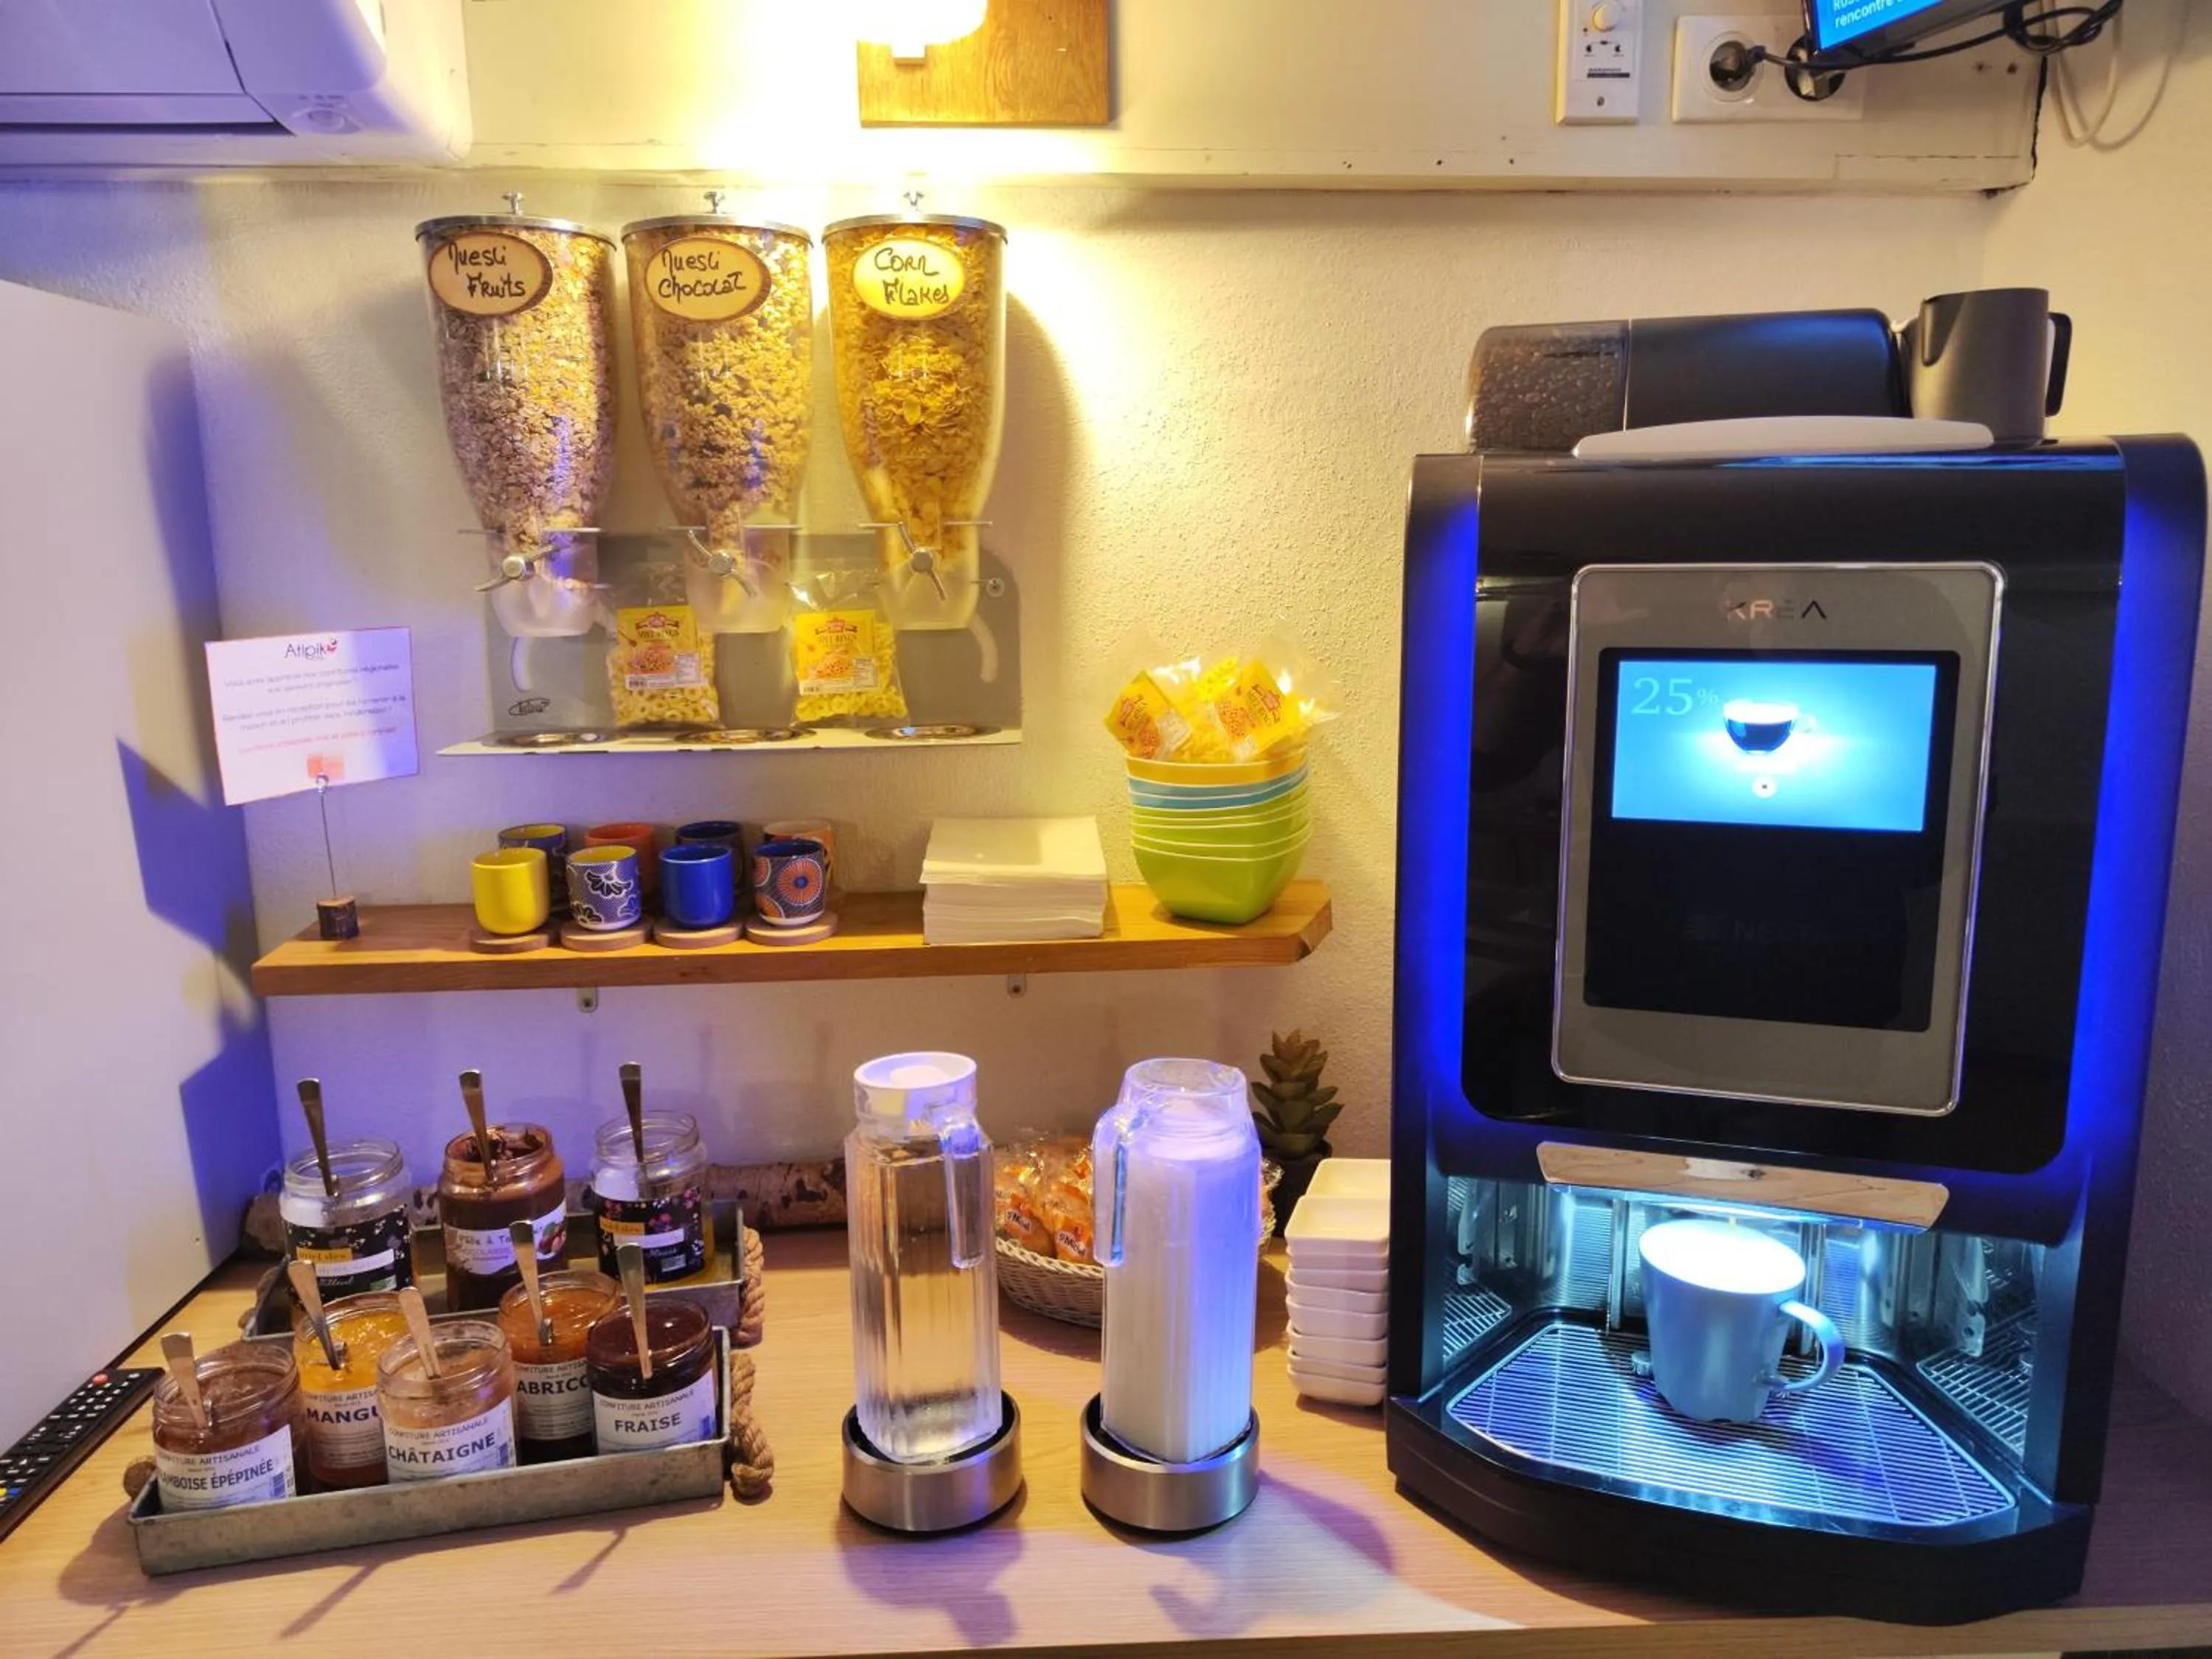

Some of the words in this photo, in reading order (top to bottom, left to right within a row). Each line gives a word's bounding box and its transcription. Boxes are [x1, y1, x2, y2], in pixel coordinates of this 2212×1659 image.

[517, 1374, 588, 1394] ABRICO
[615, 1412, 682, 1433] FRAISE
[388, 1432, 495, 1464] CHÂTAIGNE
[211, 1458, 274, 1488] ÉPÉPINÉE
